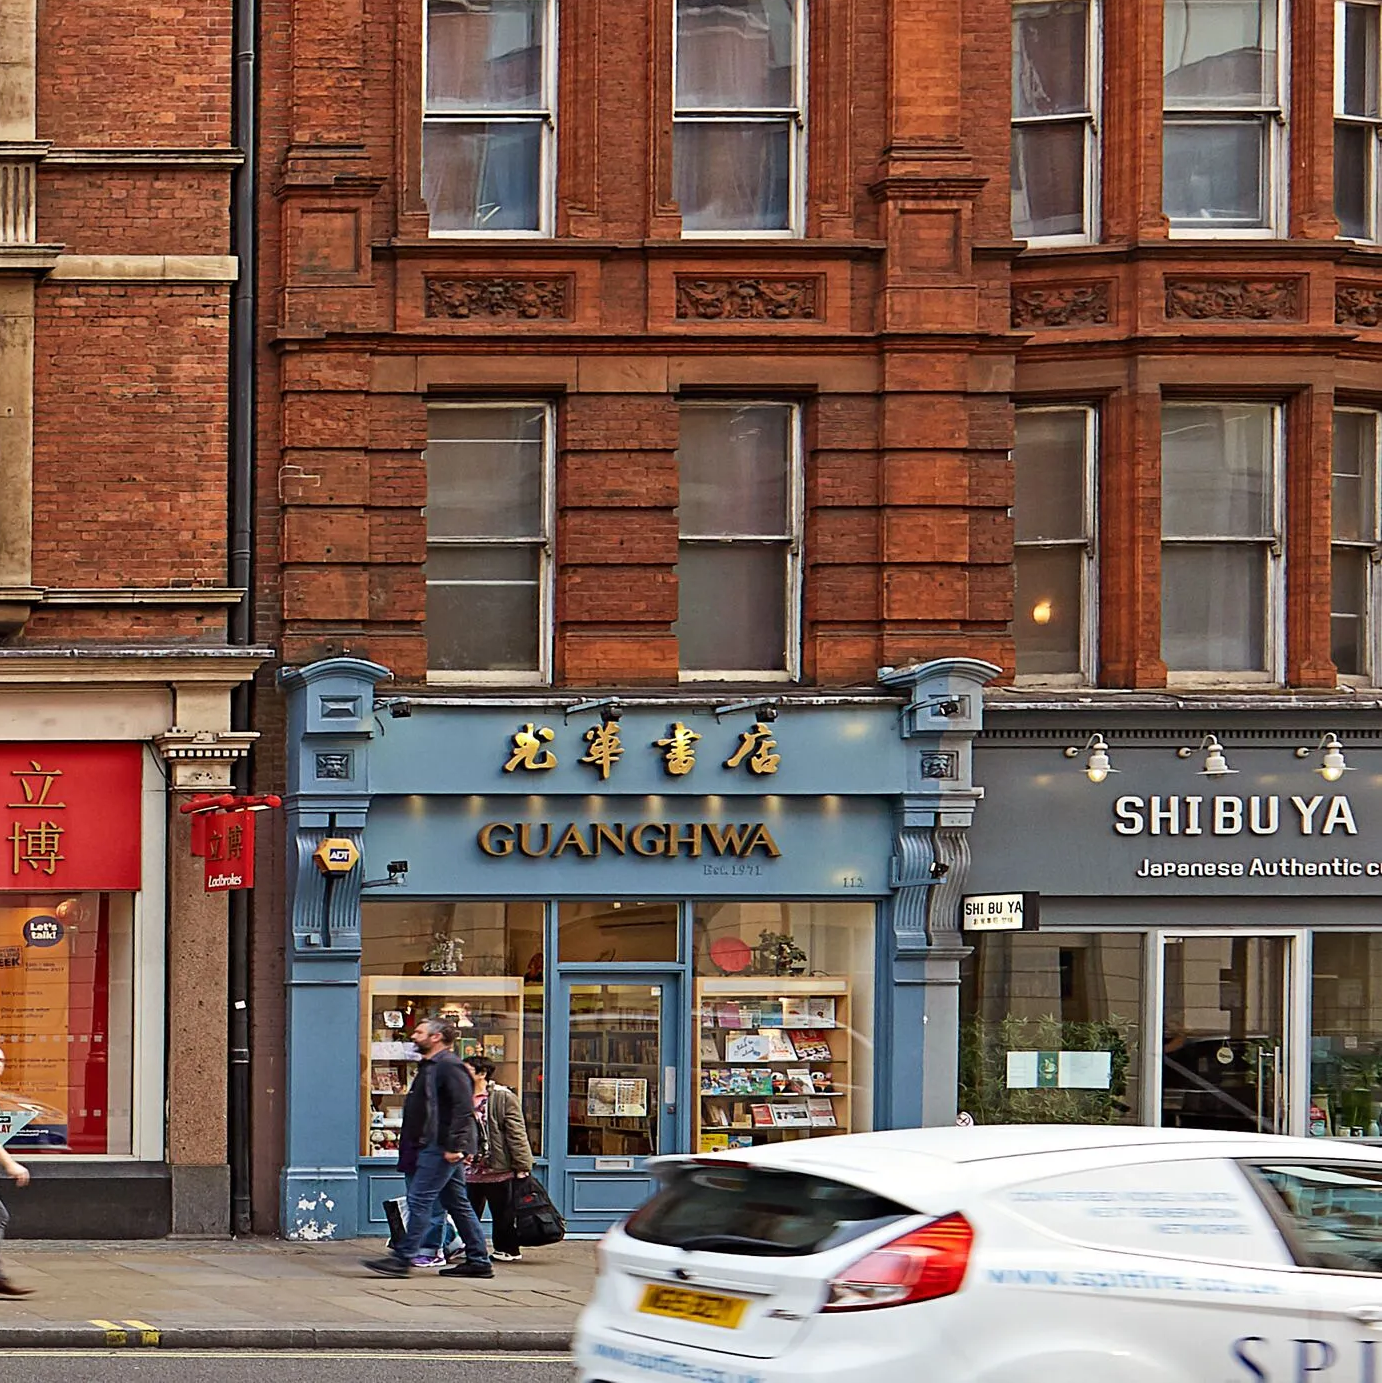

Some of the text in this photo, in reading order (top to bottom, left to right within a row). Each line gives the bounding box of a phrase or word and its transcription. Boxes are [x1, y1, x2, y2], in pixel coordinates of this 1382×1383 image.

[502, 721, 781, 781] 光華書店
[6, 760, 67, 875] 立博
[477, 822, 782, 859] GUANGHWA
[329, 851, 350, 861] ADT
[732, 865, 762, 876] 1971
[1137, 858, 1244, 877] Japanese
[1249, 858, 1362, 876] Authentic
[208, 873, 243, 888] Ladbrokes
[843, 877, 864, 888] 112
[965, 901, 1023, 916] SHI BU YA
[30, 922, 58, 931] Let's
[31, 931, 57, 939] talk!
